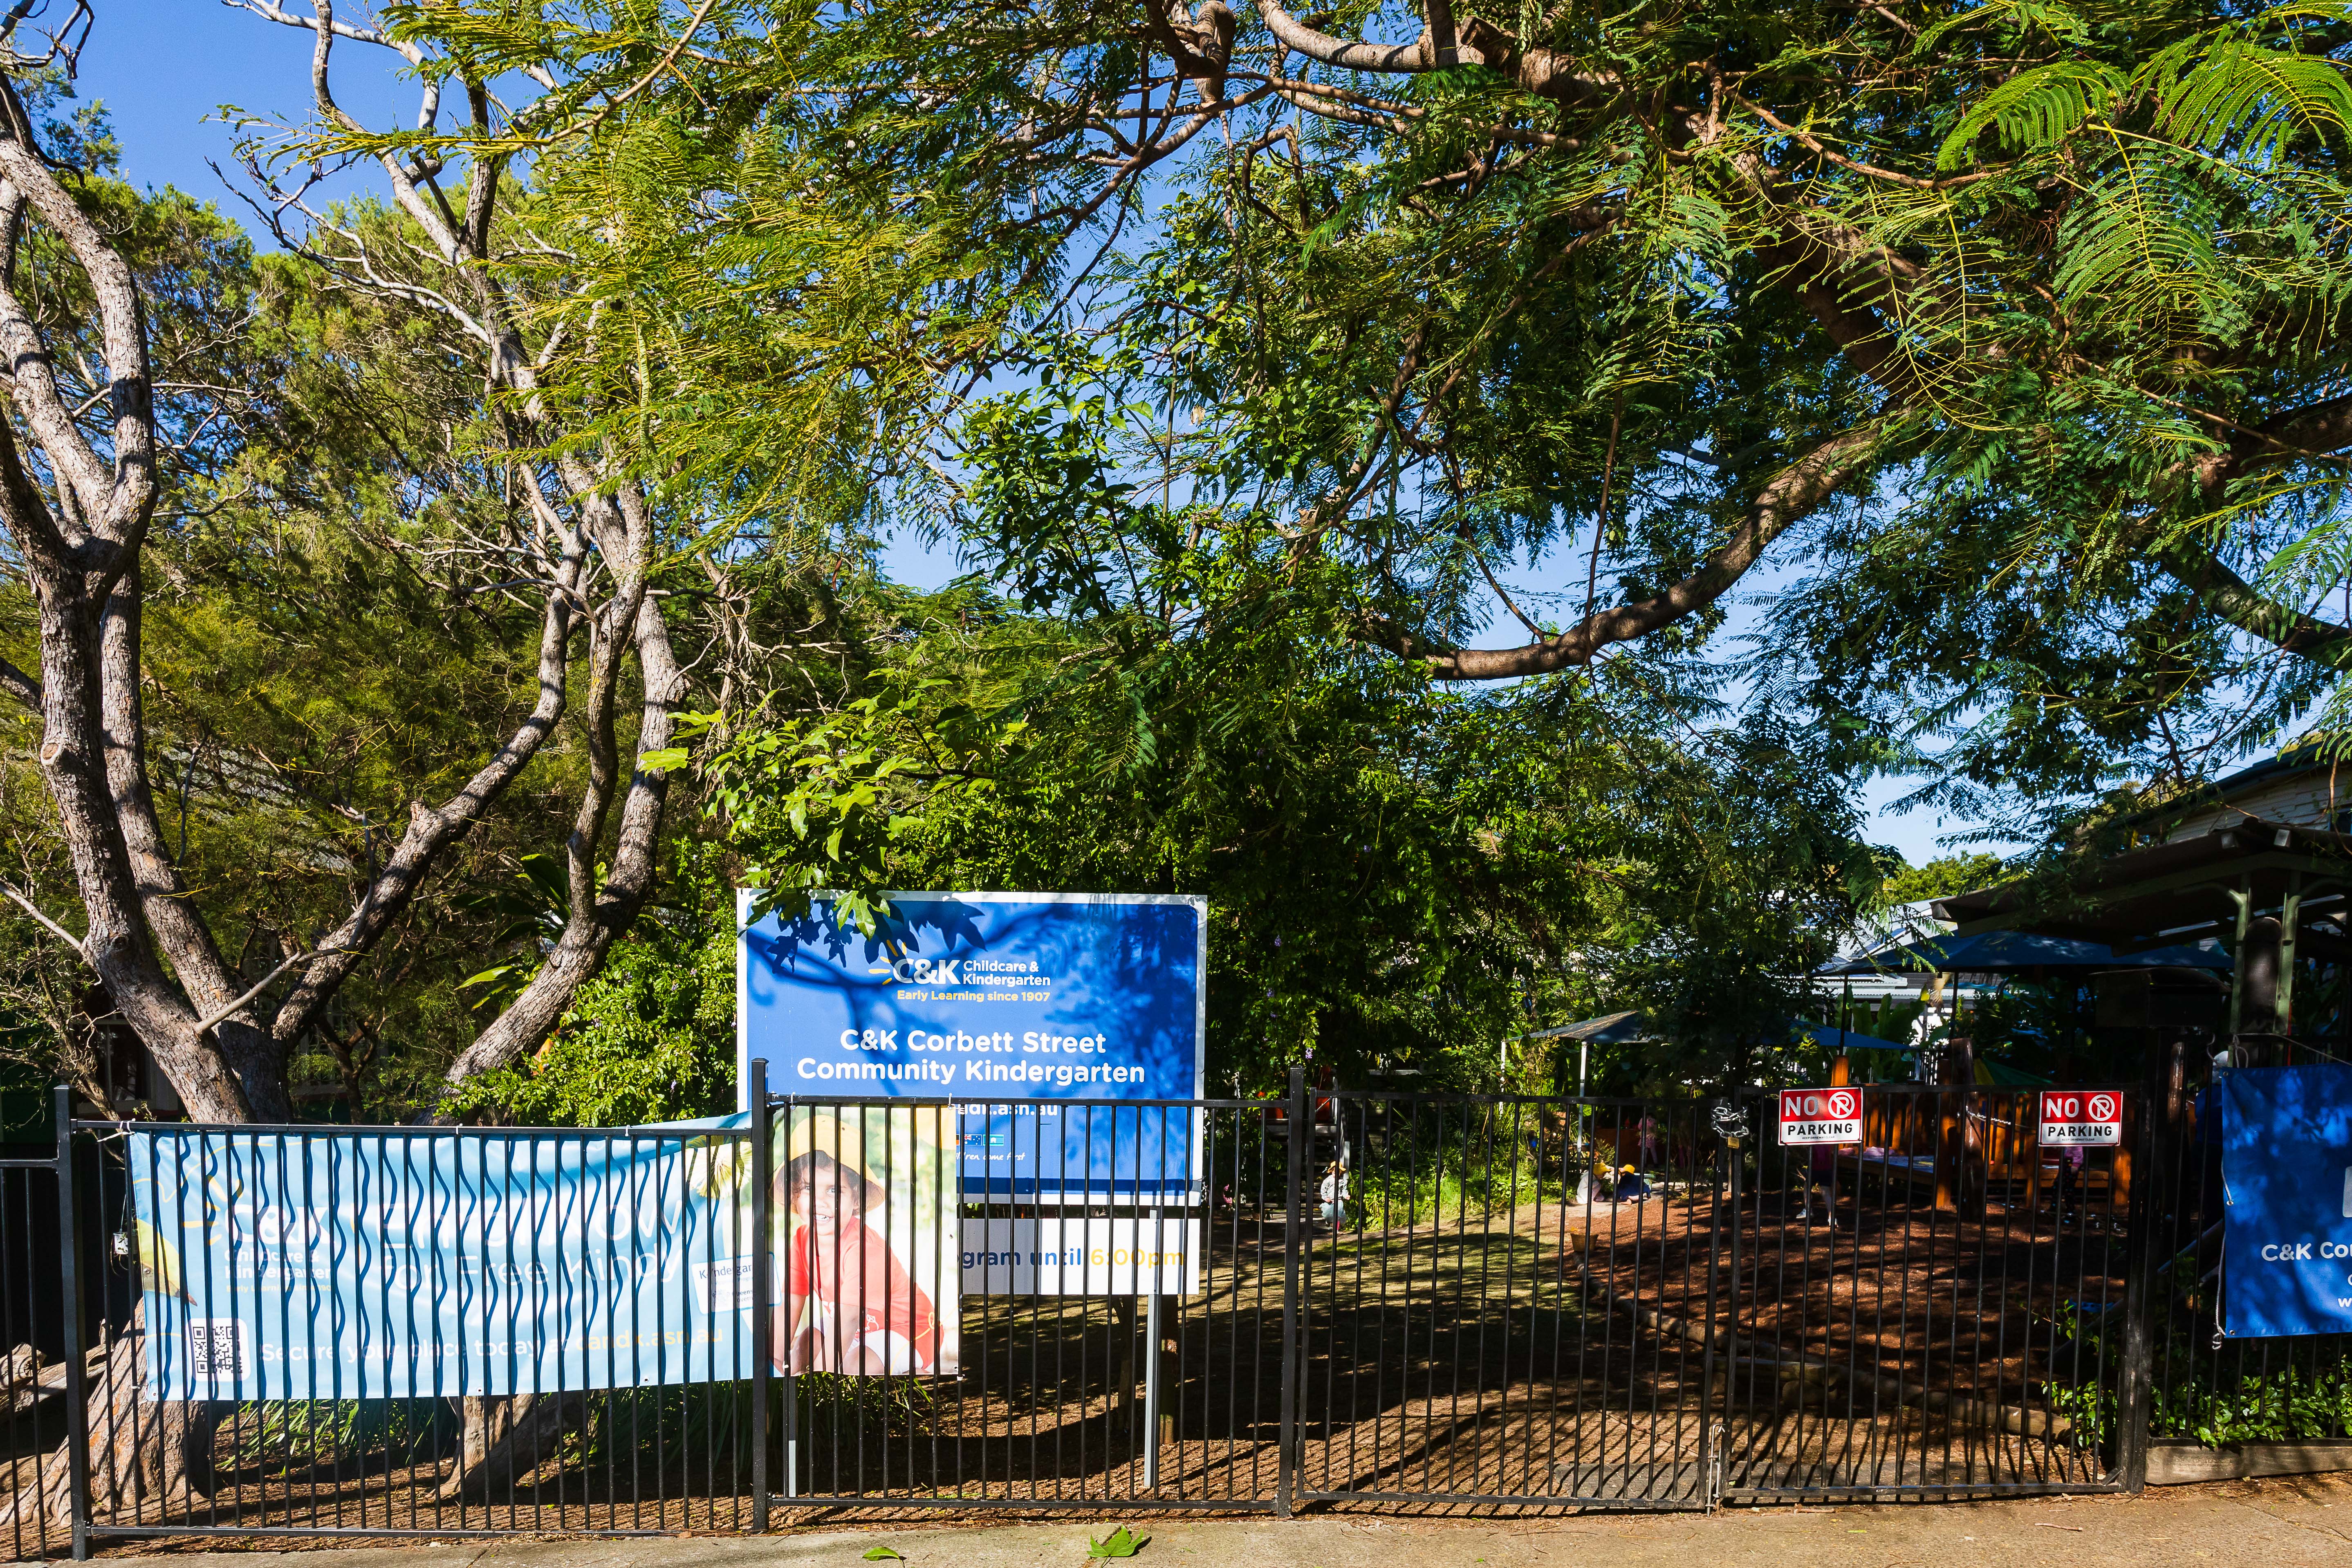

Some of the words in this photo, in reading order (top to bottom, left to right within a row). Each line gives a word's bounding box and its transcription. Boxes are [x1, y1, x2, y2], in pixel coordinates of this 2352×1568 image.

[893, 958, 961, 985] C&K
[963, 960, 1027, 972] Childcare
[1030, 961, 1039, 973] &
[963, 974, 1051, 987] Kindergarten
[897, 990, 928, 1002] Early
[931, 991, 984, 1003] Learning
[987, 991, 1018, 1001] since
[1021, 992, 1050, 1002] 1907
[840, 1029, 898, 1051] C&K
[907, 1030, 1014, 1052] Corbett
[1022, 1031, 1106, 1053] Street
[797, 1057, 956, 1085] Community
[966, 1060, 1145, 1086] Kindergarten
[1785, 1096, 1819, 1117] NO
[2046, 1098, 2079, 1118] NO
[1787, 1123, 1853, 1135] PARKING
[2048, 1126, 2112, 1137] PARKING
[2261, 1243, 2312, 1261] C&K
[455, 1255, 549, 1287] Free
[564, 1242, 682, 1283] Kindy
[347, 1344, 400, 1363] your
[411, 1339, 467, 1364] place
